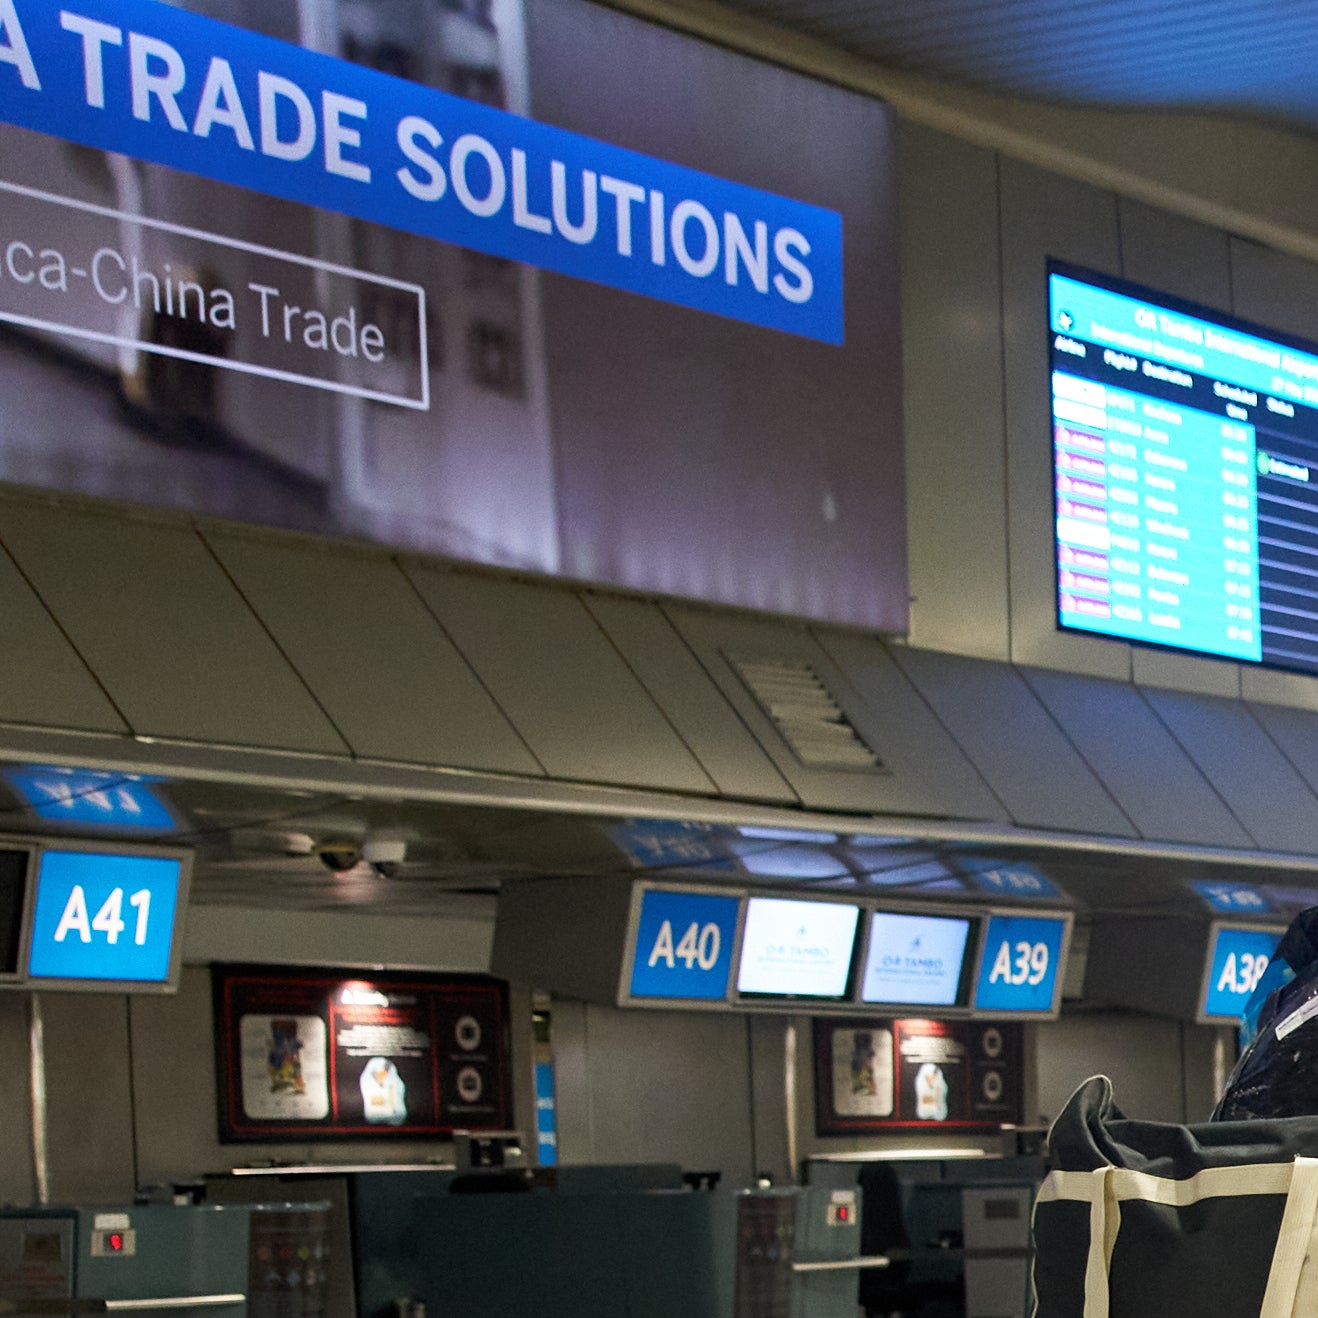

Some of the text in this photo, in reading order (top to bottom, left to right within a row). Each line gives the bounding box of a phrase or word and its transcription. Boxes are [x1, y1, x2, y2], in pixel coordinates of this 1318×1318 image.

[59, 10, 371, 184] TRADE
[396, 116, 814, 304] SOLUTIONS
[248, 283, 386, 363] Trade
[54, 885, 151, 945] A41
[648, 920, 721, 971] A40
[989, 941, 1049, 985] A39
